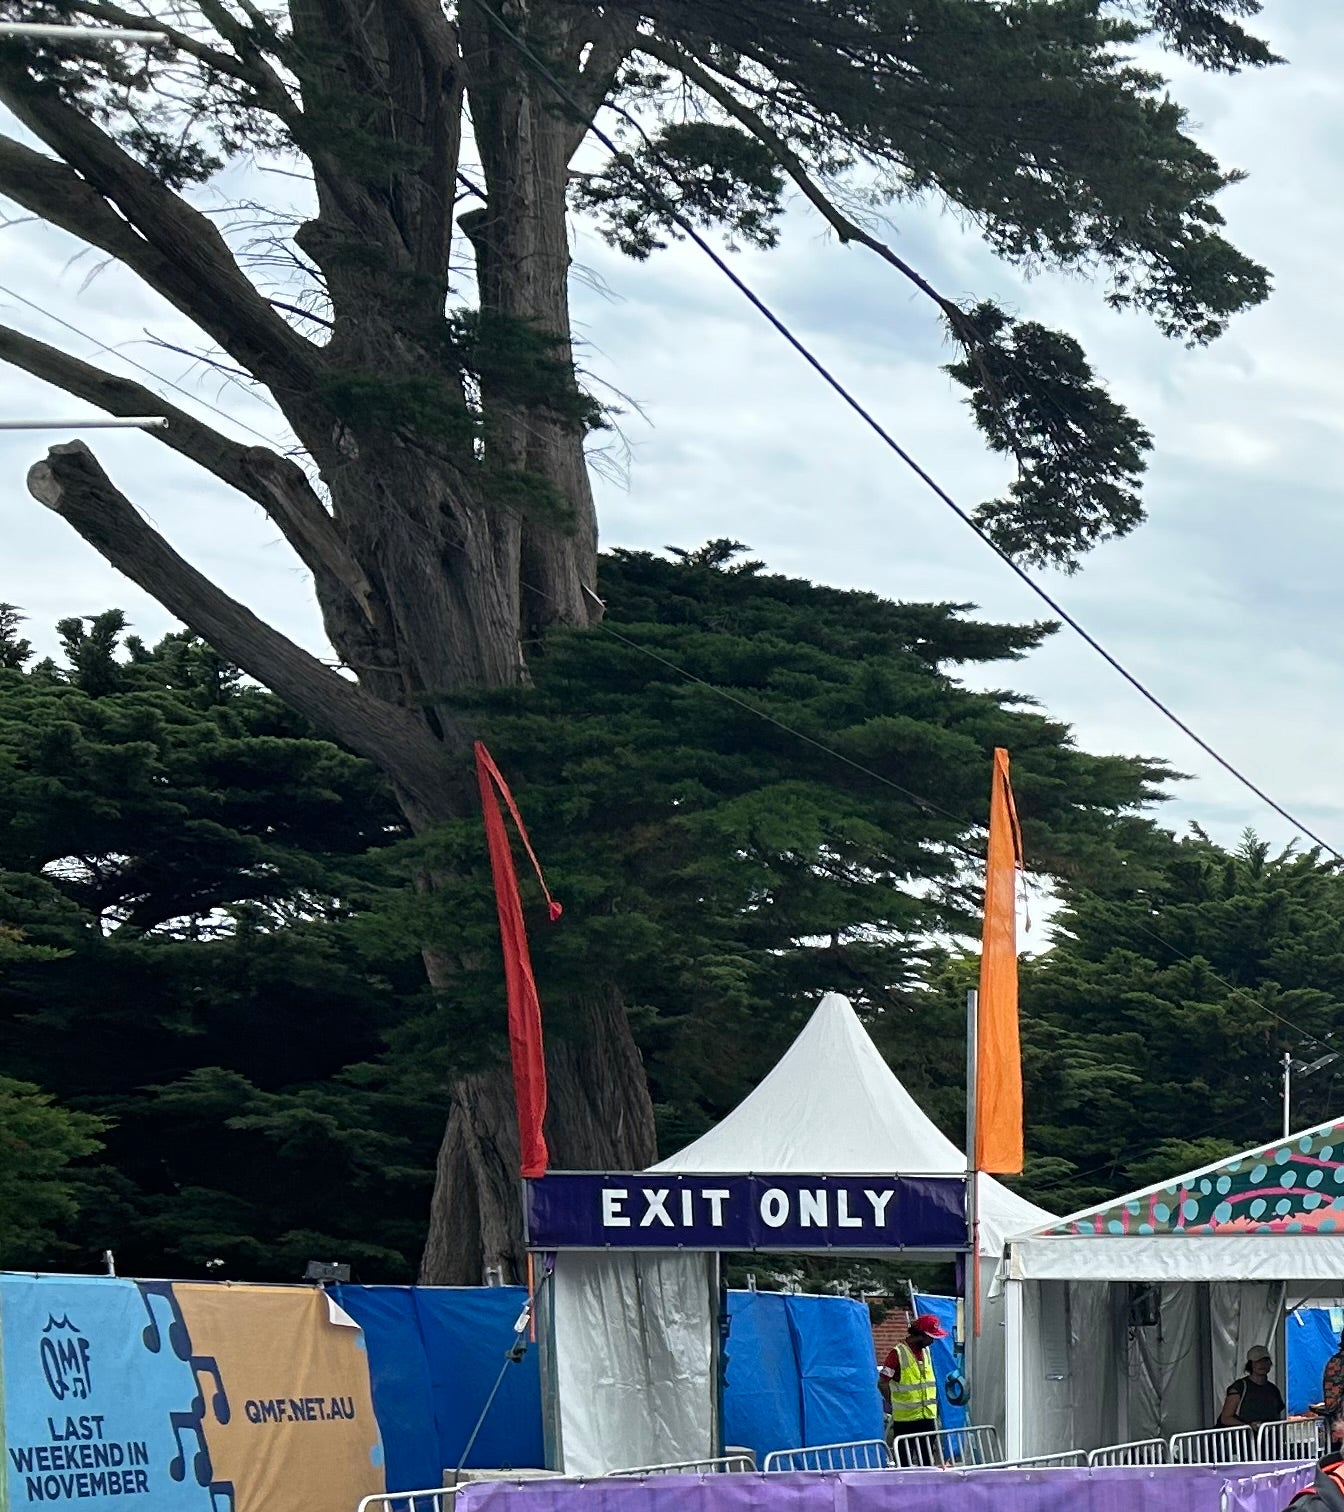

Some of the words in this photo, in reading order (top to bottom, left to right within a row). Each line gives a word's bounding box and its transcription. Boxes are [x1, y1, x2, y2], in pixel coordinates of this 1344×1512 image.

[602, 1189, 730, 1226] EXIT
[760, 1189, 895, 1228] ONLY
[41, 1337, 92, 1401] QMF
[245, 1397, 356, 1424] QMF.NET.AU
[48, 1415, 104, 1441] LAST
[9, 1443, 124, 1473] WEEKEND
[129, 1441, 149, 1465] IN
[26, 1469, 150, 1502] NOVEMBER
